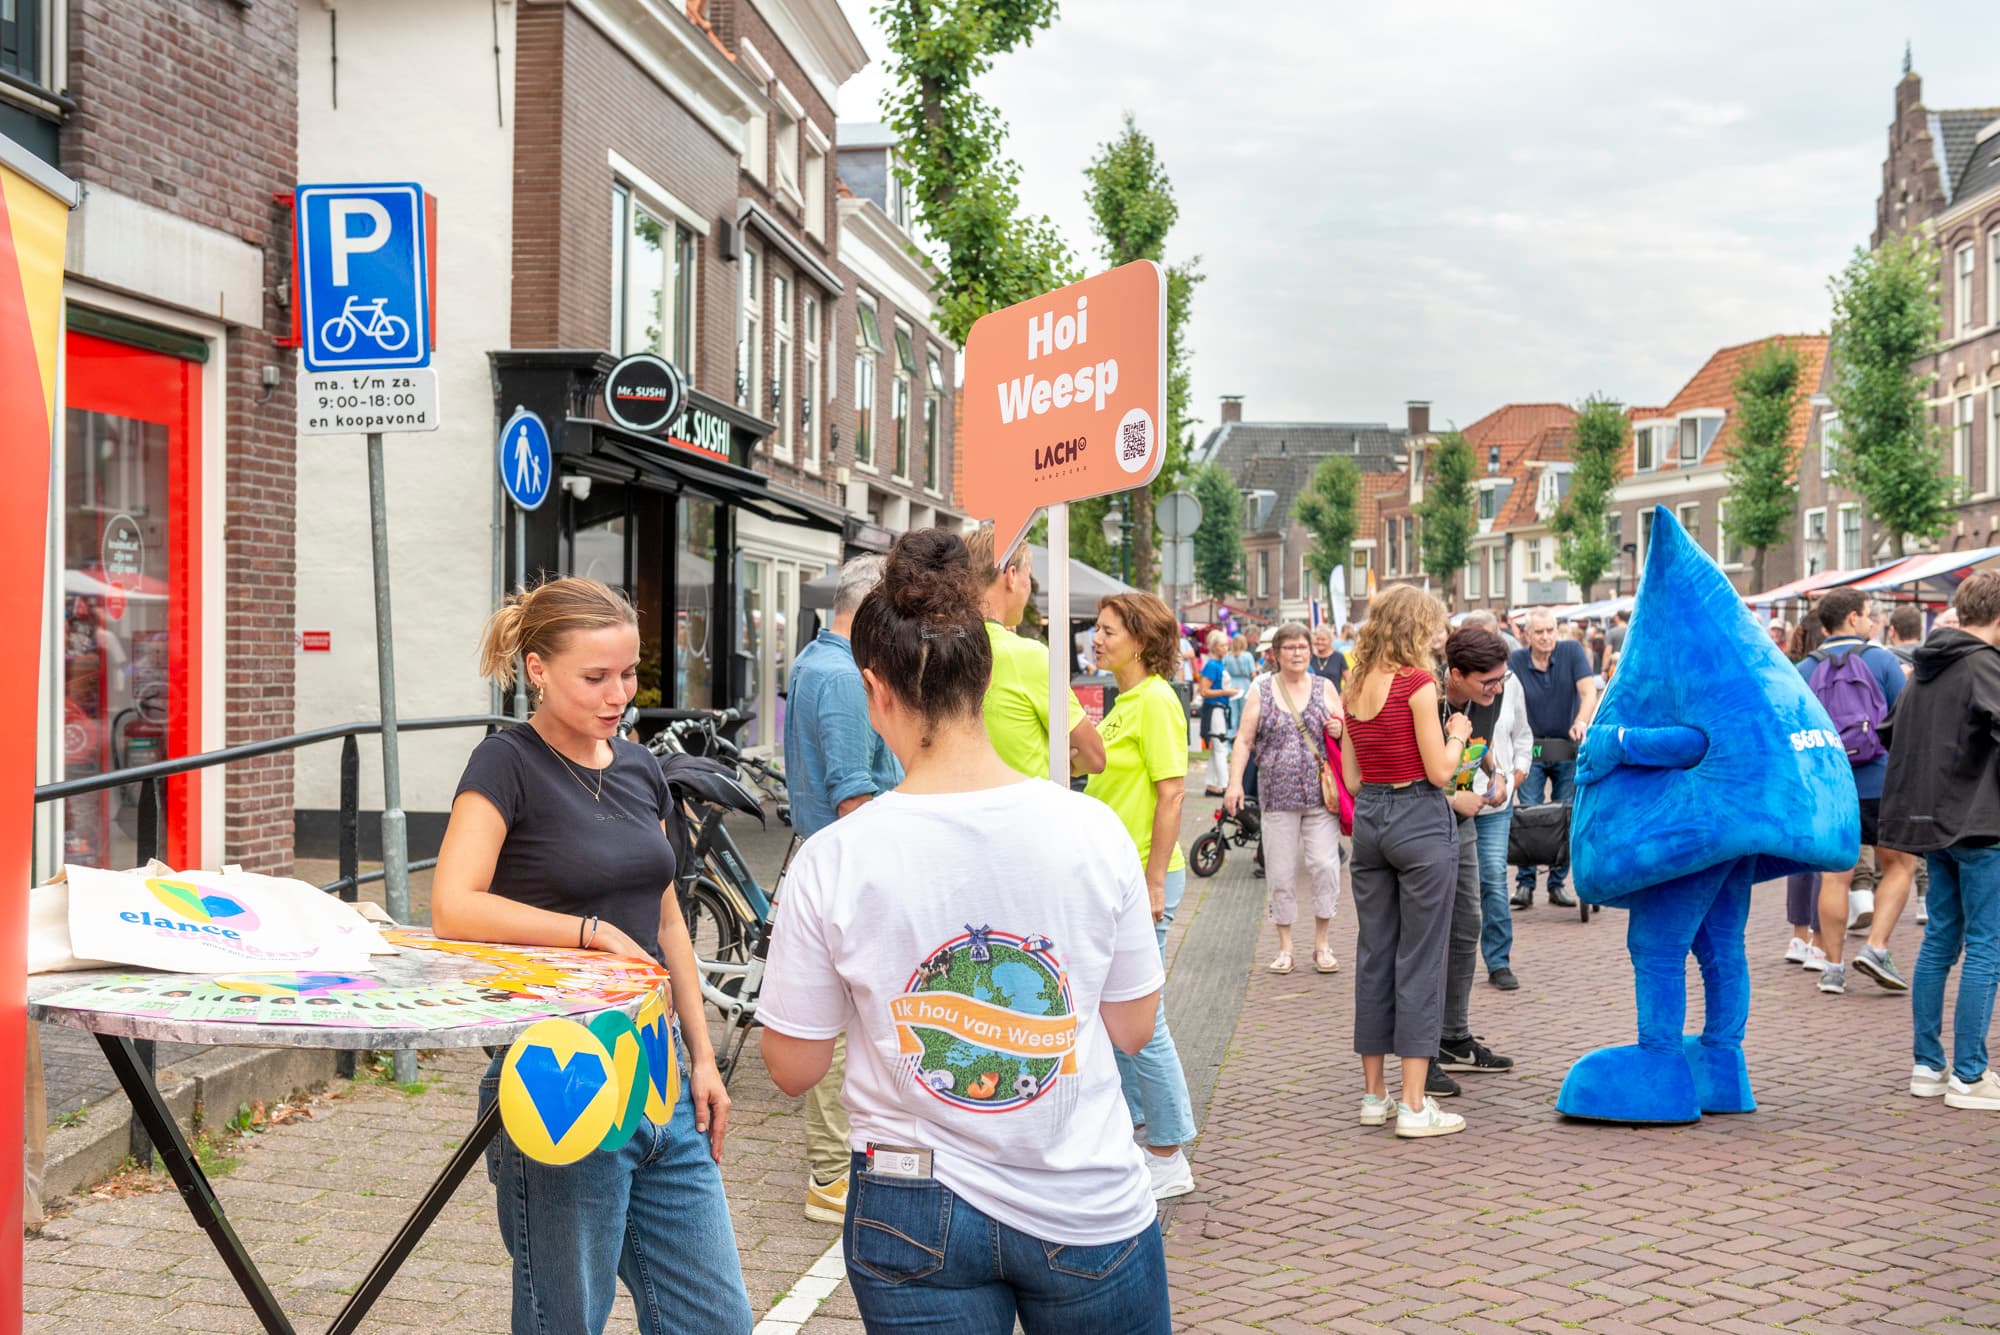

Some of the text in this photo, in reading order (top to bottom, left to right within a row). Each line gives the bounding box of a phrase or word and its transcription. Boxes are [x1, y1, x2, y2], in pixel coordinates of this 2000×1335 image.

[329, 198, 392, 287] P
[1027, 295, 1088, 361] Hoi
[314, 375, 416, 391] ma. t/m za.
[318, 393, 416, 409] 9:00-18:00
[616, 385, 667, 398] Mr. SUSHI
[997, 358, 1119, 425] Weesp
[309, 411, 426, 428] en koopavond
[693, 409, 731, 457] SUSHI
[119, 911, 241, 941] elance
[895, 999, 1076, 1048] Ik hou van Weesp
